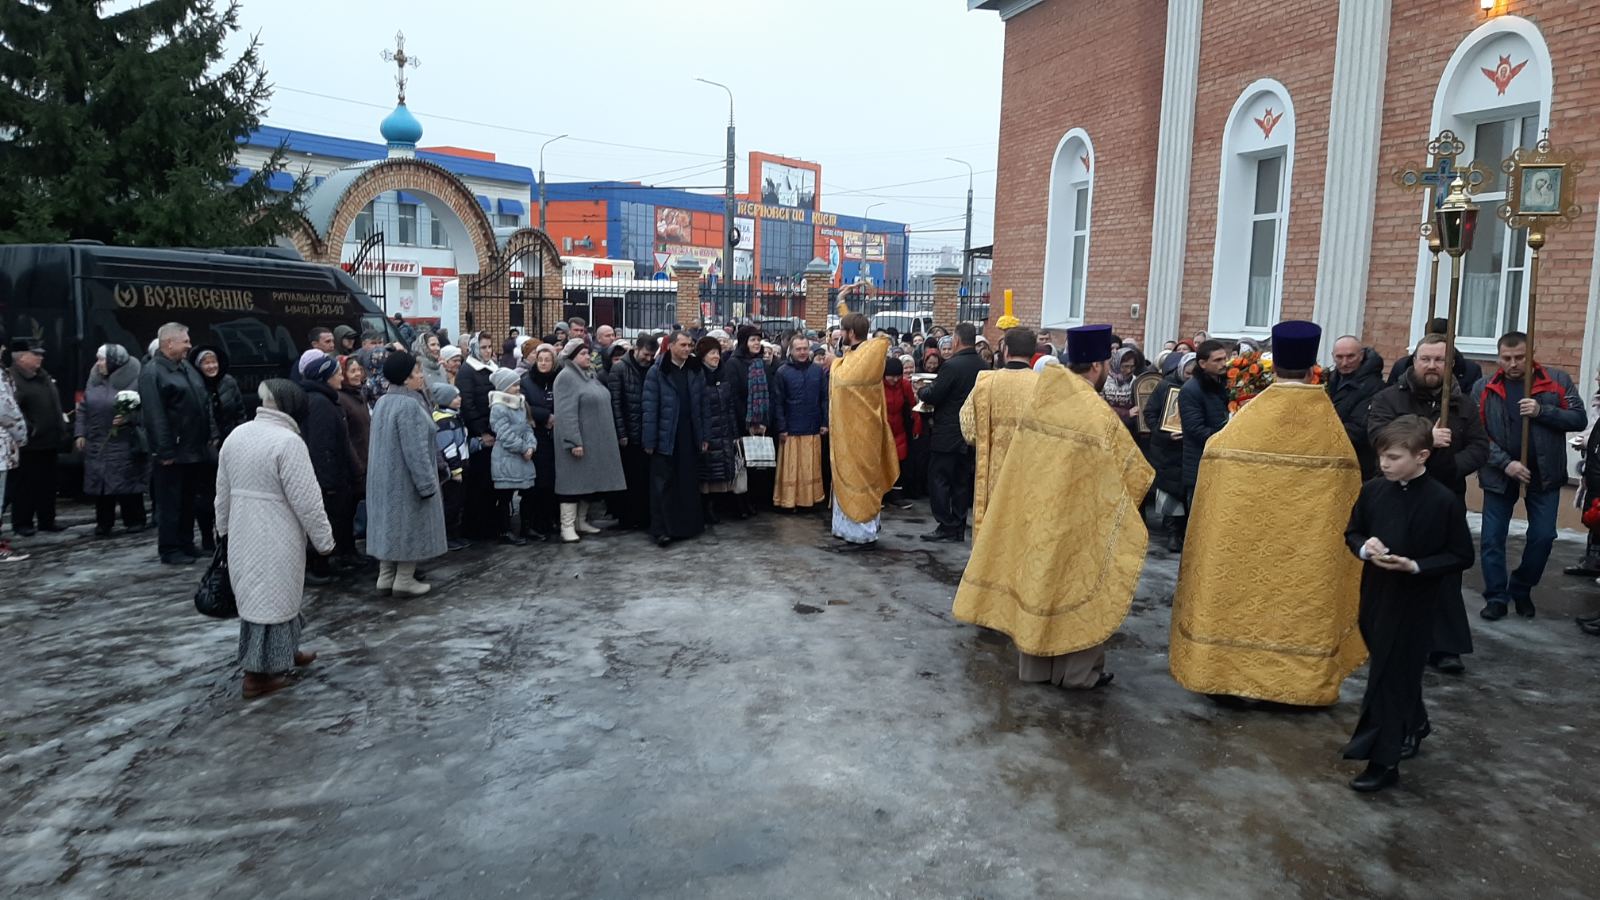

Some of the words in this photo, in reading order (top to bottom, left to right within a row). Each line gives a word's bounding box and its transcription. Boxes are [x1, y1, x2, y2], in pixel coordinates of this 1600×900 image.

[143, 285, 254, 311] ВОЗНЕСЕНИЕ
[272, 291, 321, 302] РИТУАЛЬНАЯ
[322, 293, 351, 304] СЛУЖБА
